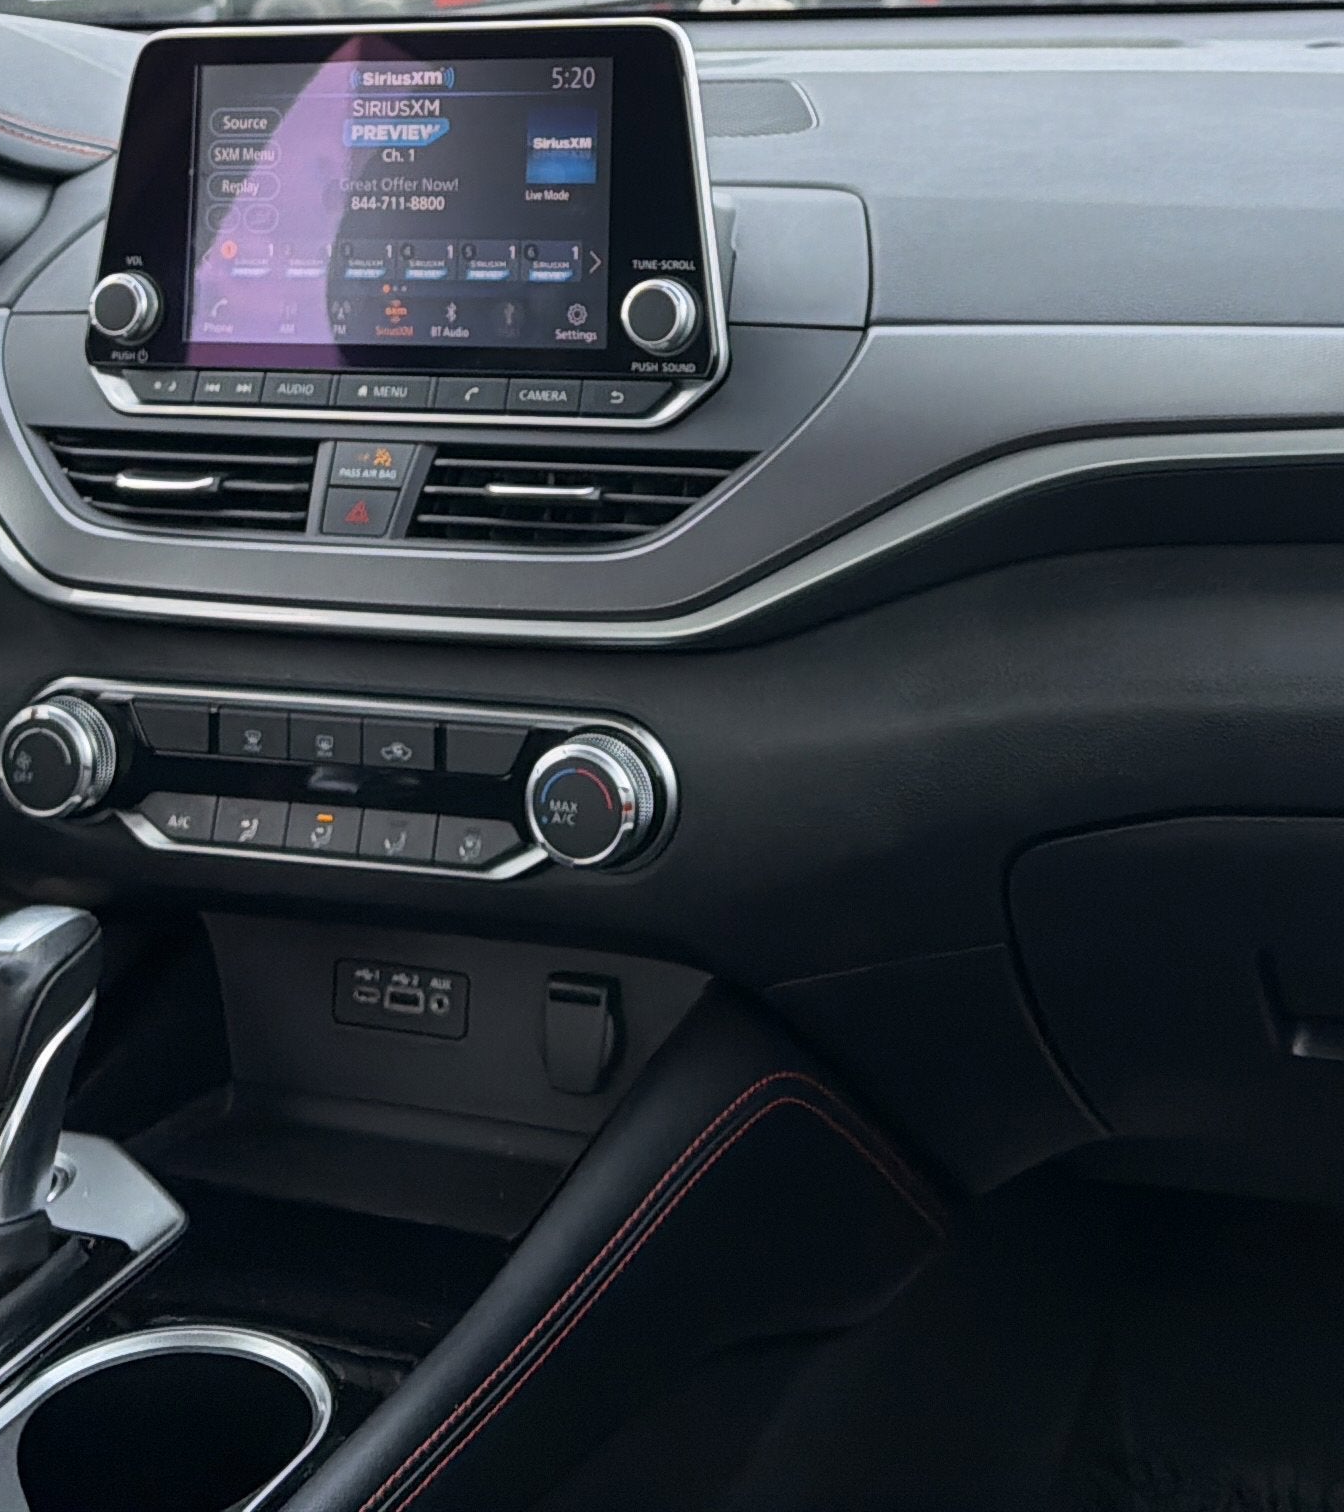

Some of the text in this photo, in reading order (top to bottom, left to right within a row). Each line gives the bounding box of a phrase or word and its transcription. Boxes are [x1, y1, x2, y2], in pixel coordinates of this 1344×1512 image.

[551, 66, 597, 89] 5:20
[352, 98, 441, 117] SIRIUSXM
[222, 115, 268, 130] Source
[351, 123, 442, 141] PREVIEW
[532, 137, 593, 149] SiriusXM
[213, 147, 276, 162] SXM Menu
[381, 148, 416, 163] Ch. 1
[221, 179, 260, 196] Replay
[340, 177, 459, 192] Great Offer Now!
[525, 189, 570, 201] Live Mode
[351, 196, 446, 211] 844-711-8800
[268, 243, 274, 257] 1
[326, 243, 333, 258] 1
[386, 244, 393, 259] 1
[446, 244, 454, 259] 1
[509, 245, 516, 259] 1
[571, 245, 579, 260] 1
[126, 255, 144, 267] VOL
[631, 259, 697, 271] TUNE-SCROLL
[430, 326, 470, 339] BT Audio
[555, 328, 598, 343] Settings
[111, 350, 136, 361] PUSH
[630, 361, 697, 374] PUSH SOUND
[276, 383, 315, 396] AUDIO
[373, 385, 409, 398] MENU
[518, 389, 568, 402] CAMERA
[378, 469, 398, 480] BAG
[549, 798, 578, 814] MAX
[167, 813, 193, 830] A/C
[549, 812, 577, 827] A/C
